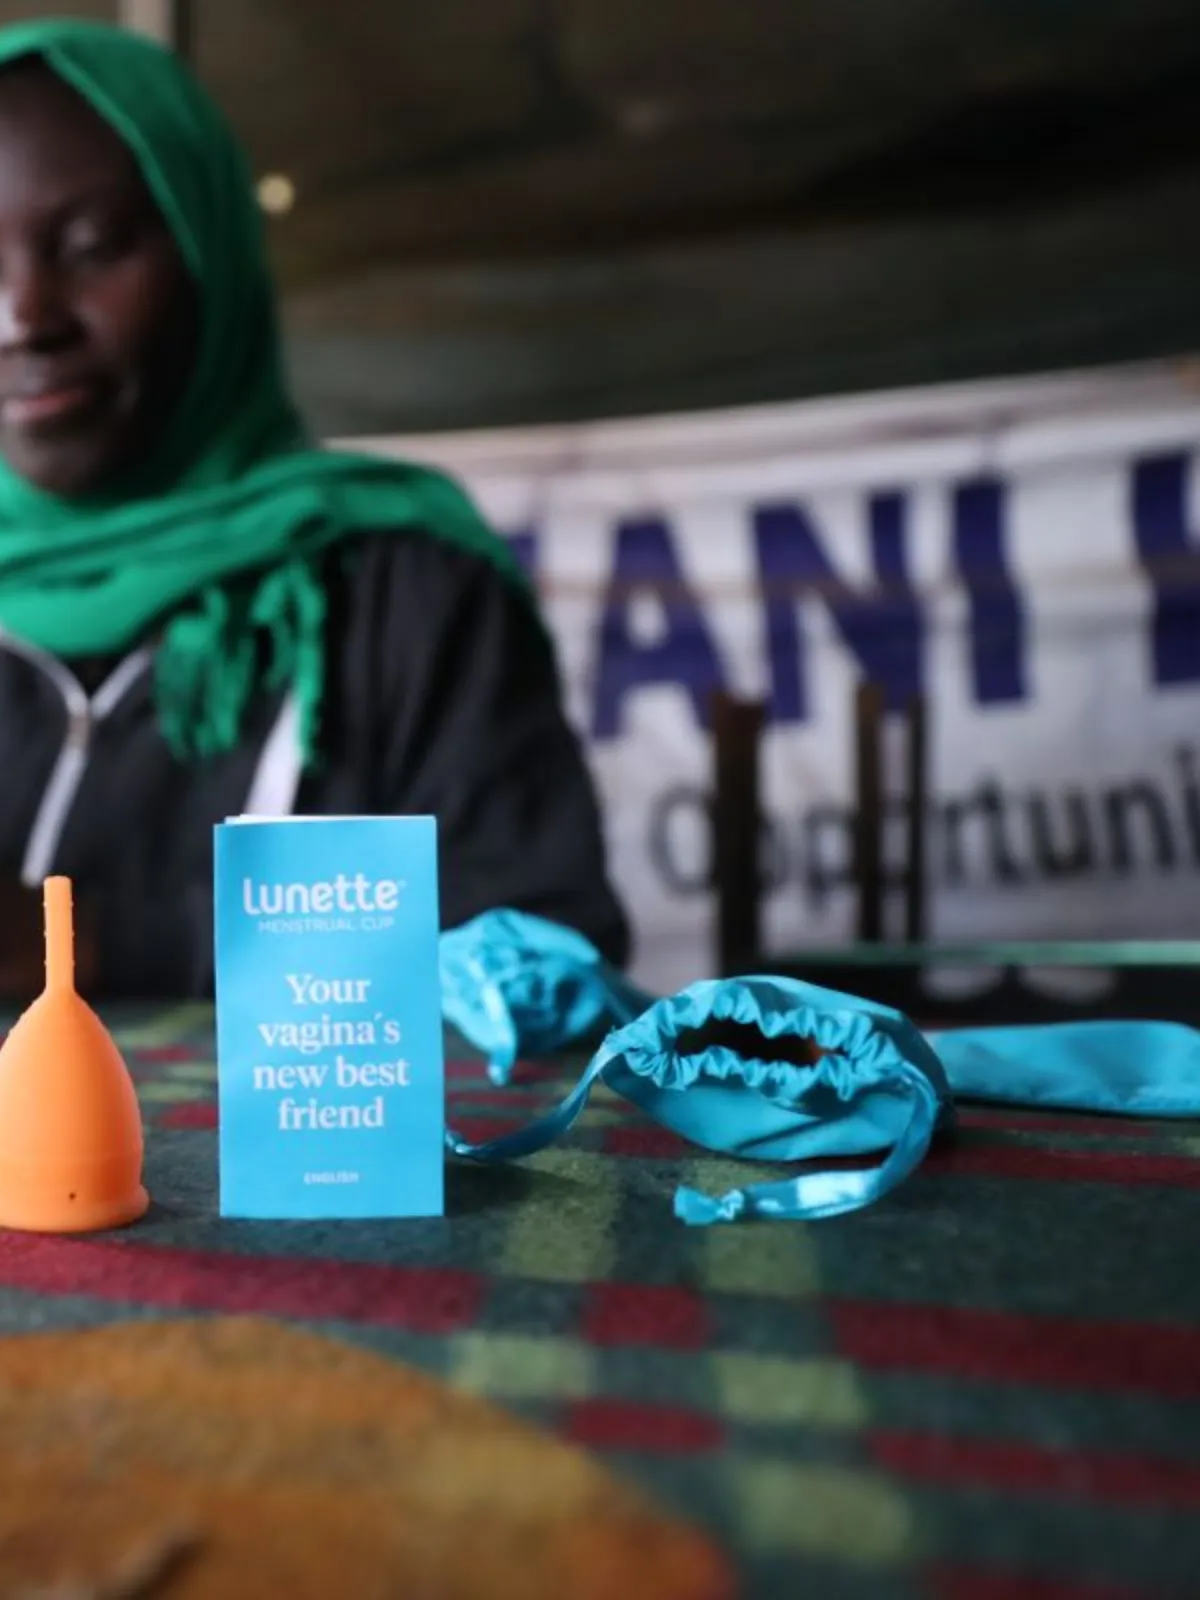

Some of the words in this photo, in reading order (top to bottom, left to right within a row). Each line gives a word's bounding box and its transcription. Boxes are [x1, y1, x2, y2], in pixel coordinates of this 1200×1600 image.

[258, 917, 355, 934] MENSTRUAL
[359, 916, 395, 931] CUP
[285, 973, 372, 1005] Your
[253, 1064, 329, 1090] new
[335, 1053, 410, 1088] best
[278, 1096, 384, 1130] friend
